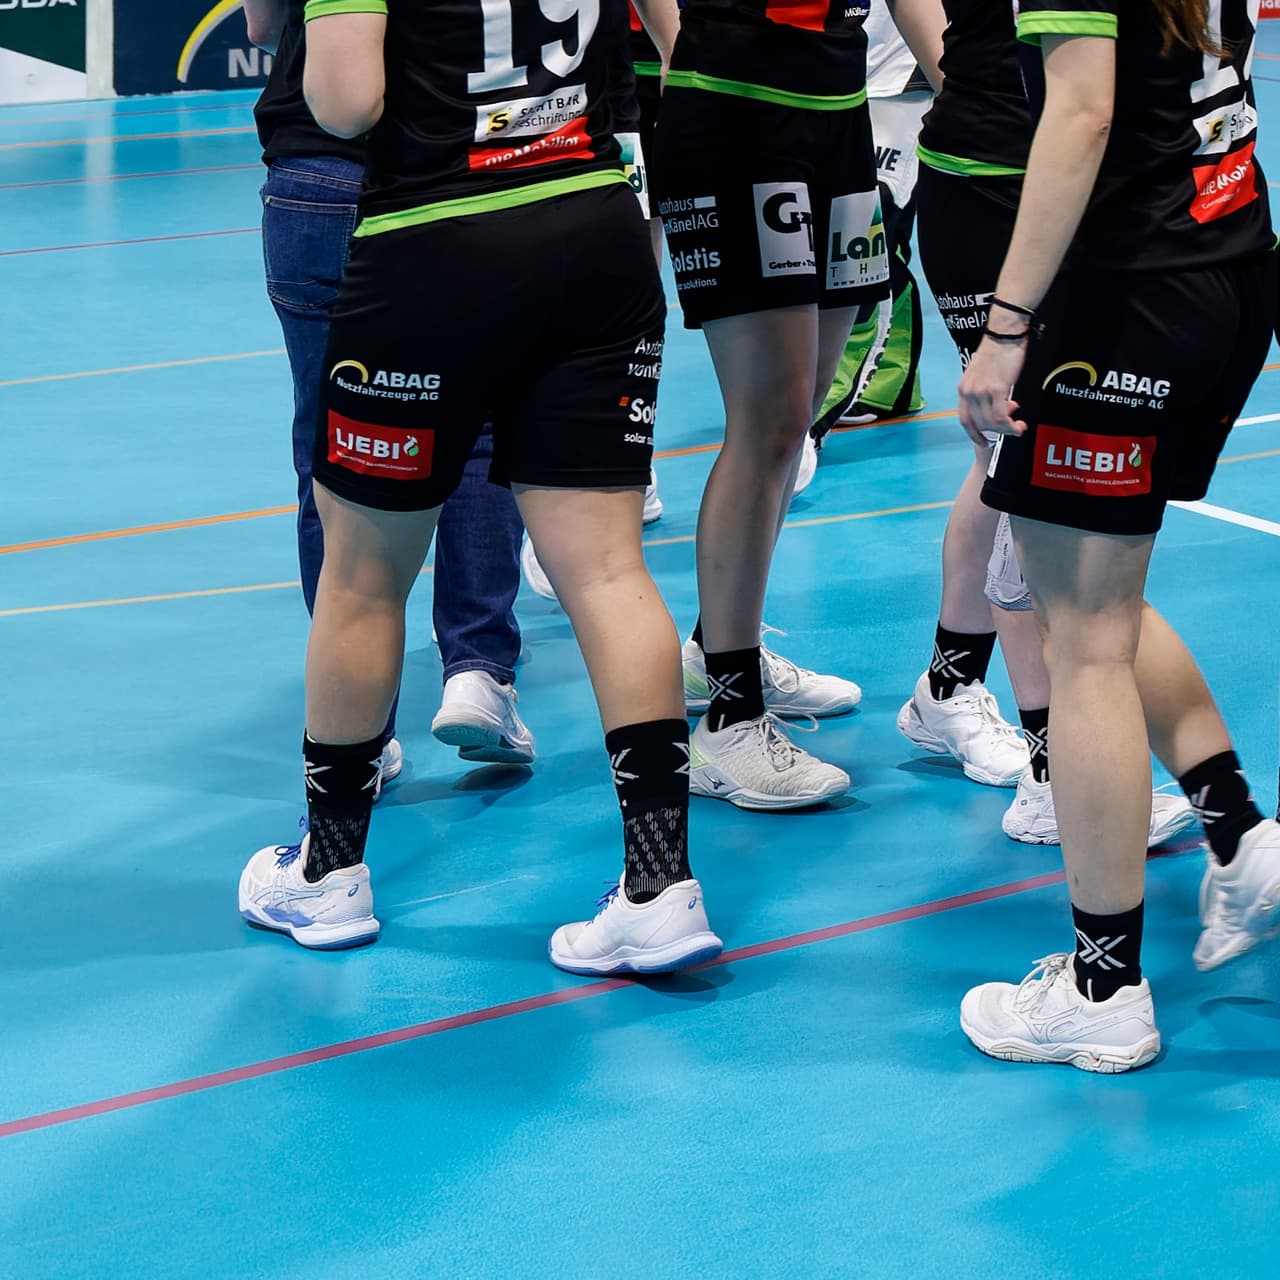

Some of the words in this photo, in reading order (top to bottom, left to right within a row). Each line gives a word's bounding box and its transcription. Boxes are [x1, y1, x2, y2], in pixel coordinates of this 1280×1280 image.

[373, 370, 441, 390] ABAG
[1102, 370, 1171, 398] ABAG
[419, 392, 439, 401] AG
[336, 428, 399, 460] LIEBI
[1047, 444, 1124, 473] LIEBI
